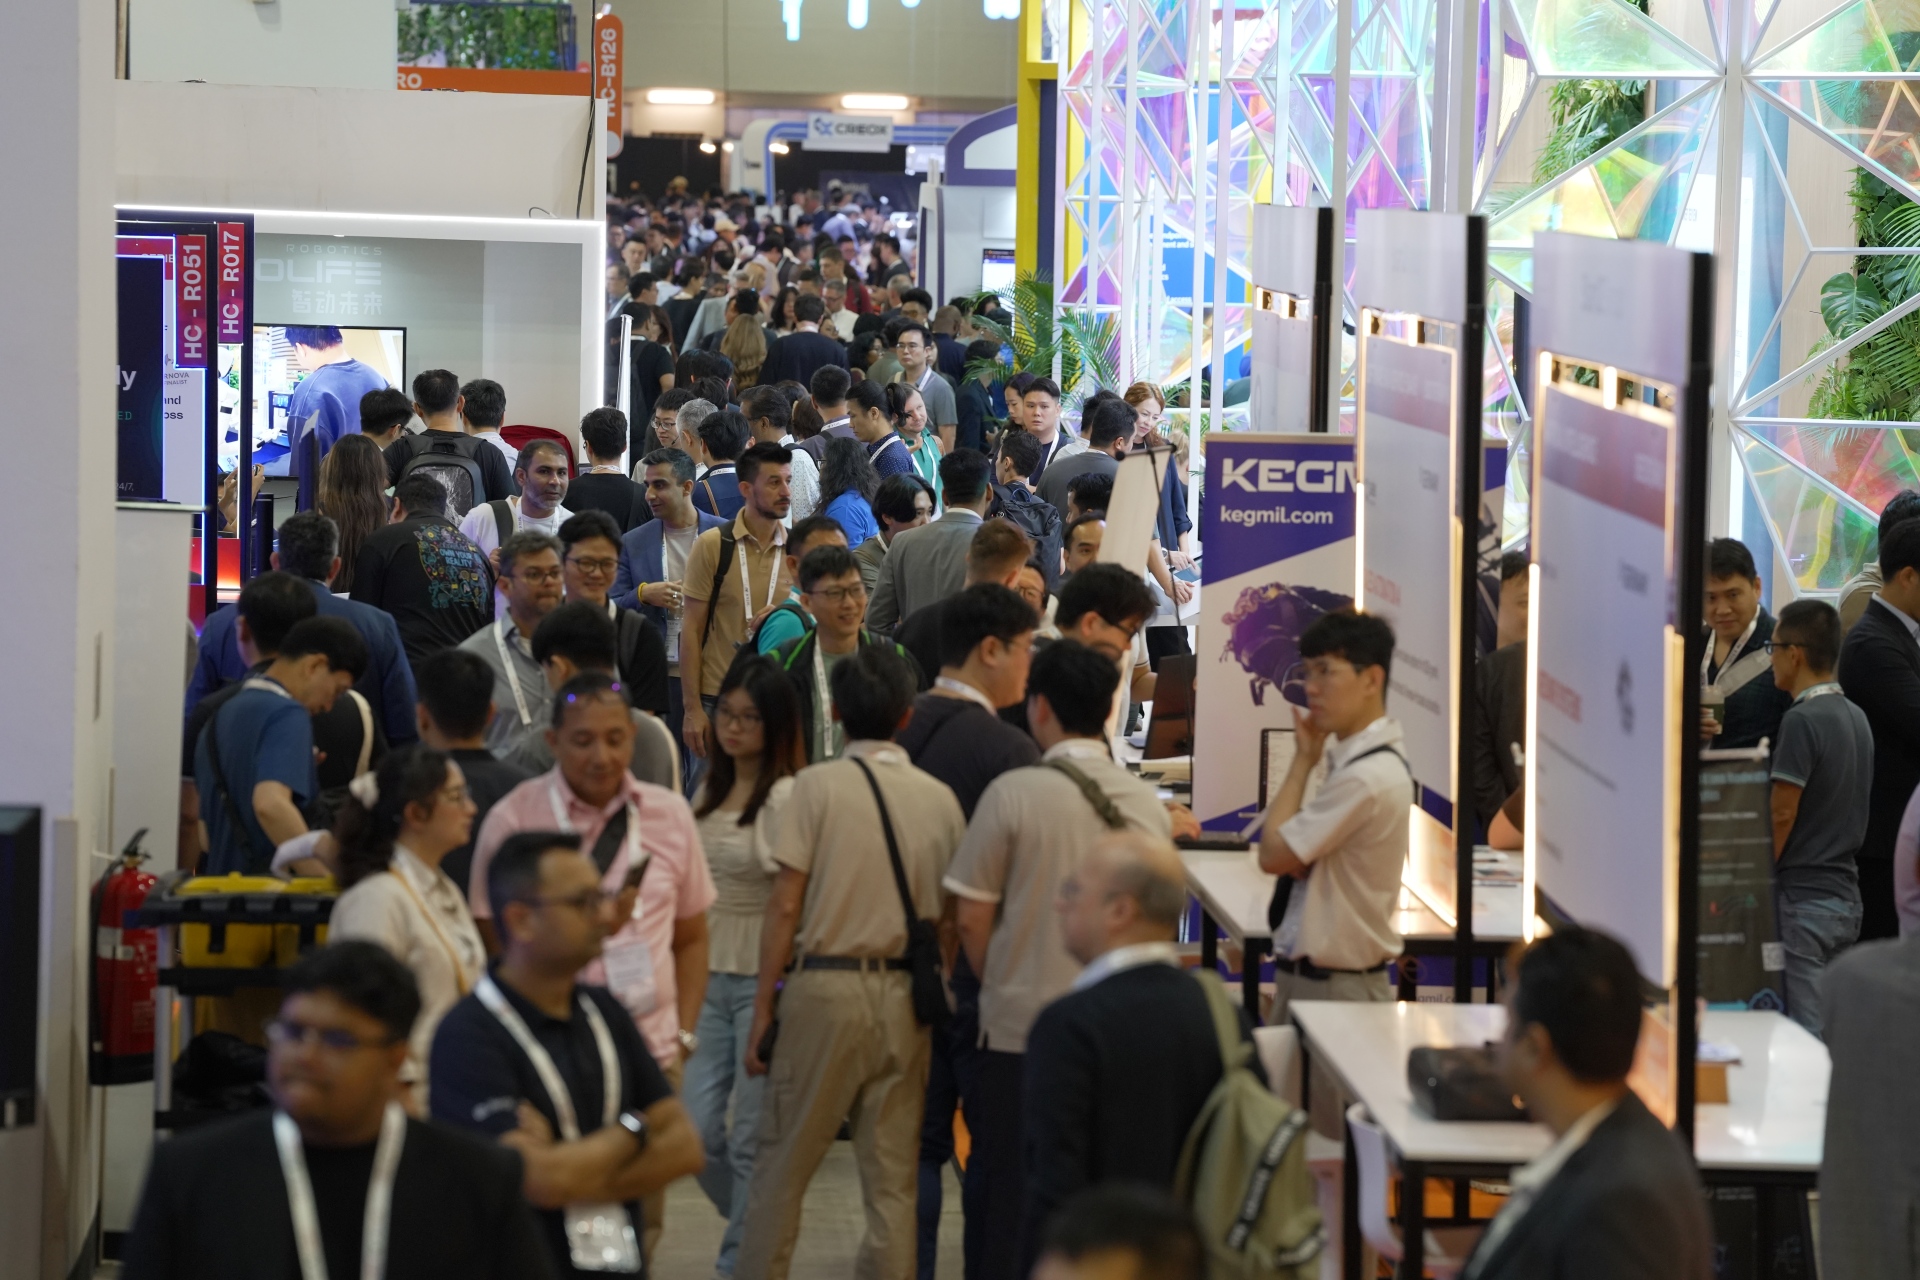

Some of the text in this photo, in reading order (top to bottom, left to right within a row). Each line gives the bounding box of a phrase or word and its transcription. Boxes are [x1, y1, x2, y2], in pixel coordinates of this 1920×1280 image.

[223, 231, 240, 282] R017
[286, 243, 383, 256] ROBOTICS
[183, 245, 202, 301] R051
[291, 288, 383, 316] 智动未来
[222, 303, 239, 334] HC
[183, 325, 202, 359] HC
[1220, 505, 1334, 528] kegmil.com
